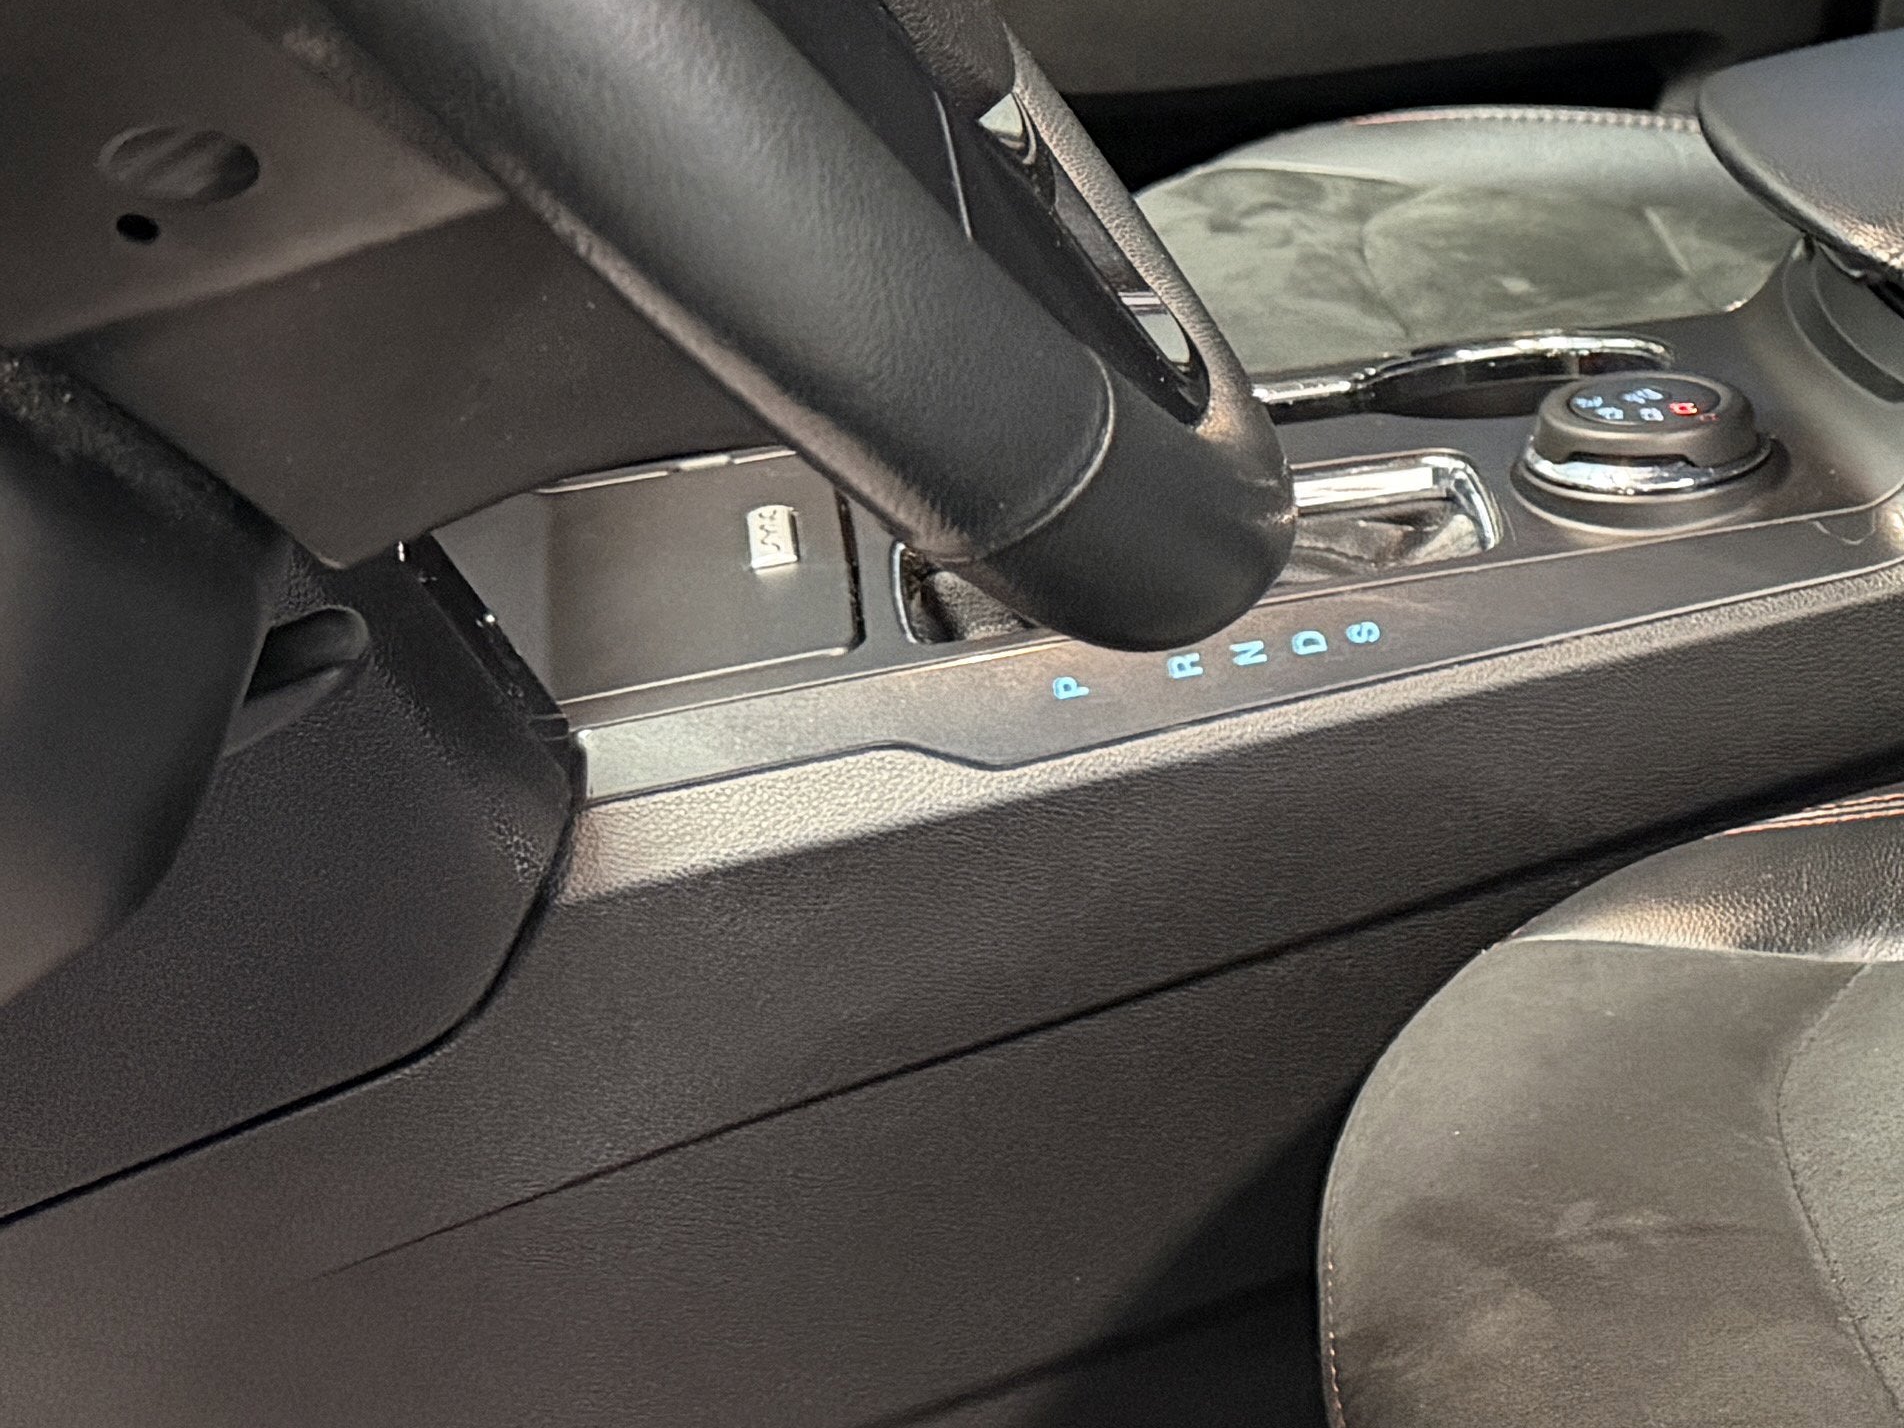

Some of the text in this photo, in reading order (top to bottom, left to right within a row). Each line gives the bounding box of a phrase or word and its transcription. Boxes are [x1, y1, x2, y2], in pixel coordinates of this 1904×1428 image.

[1053, 621, 1380, 700] P R N D S
